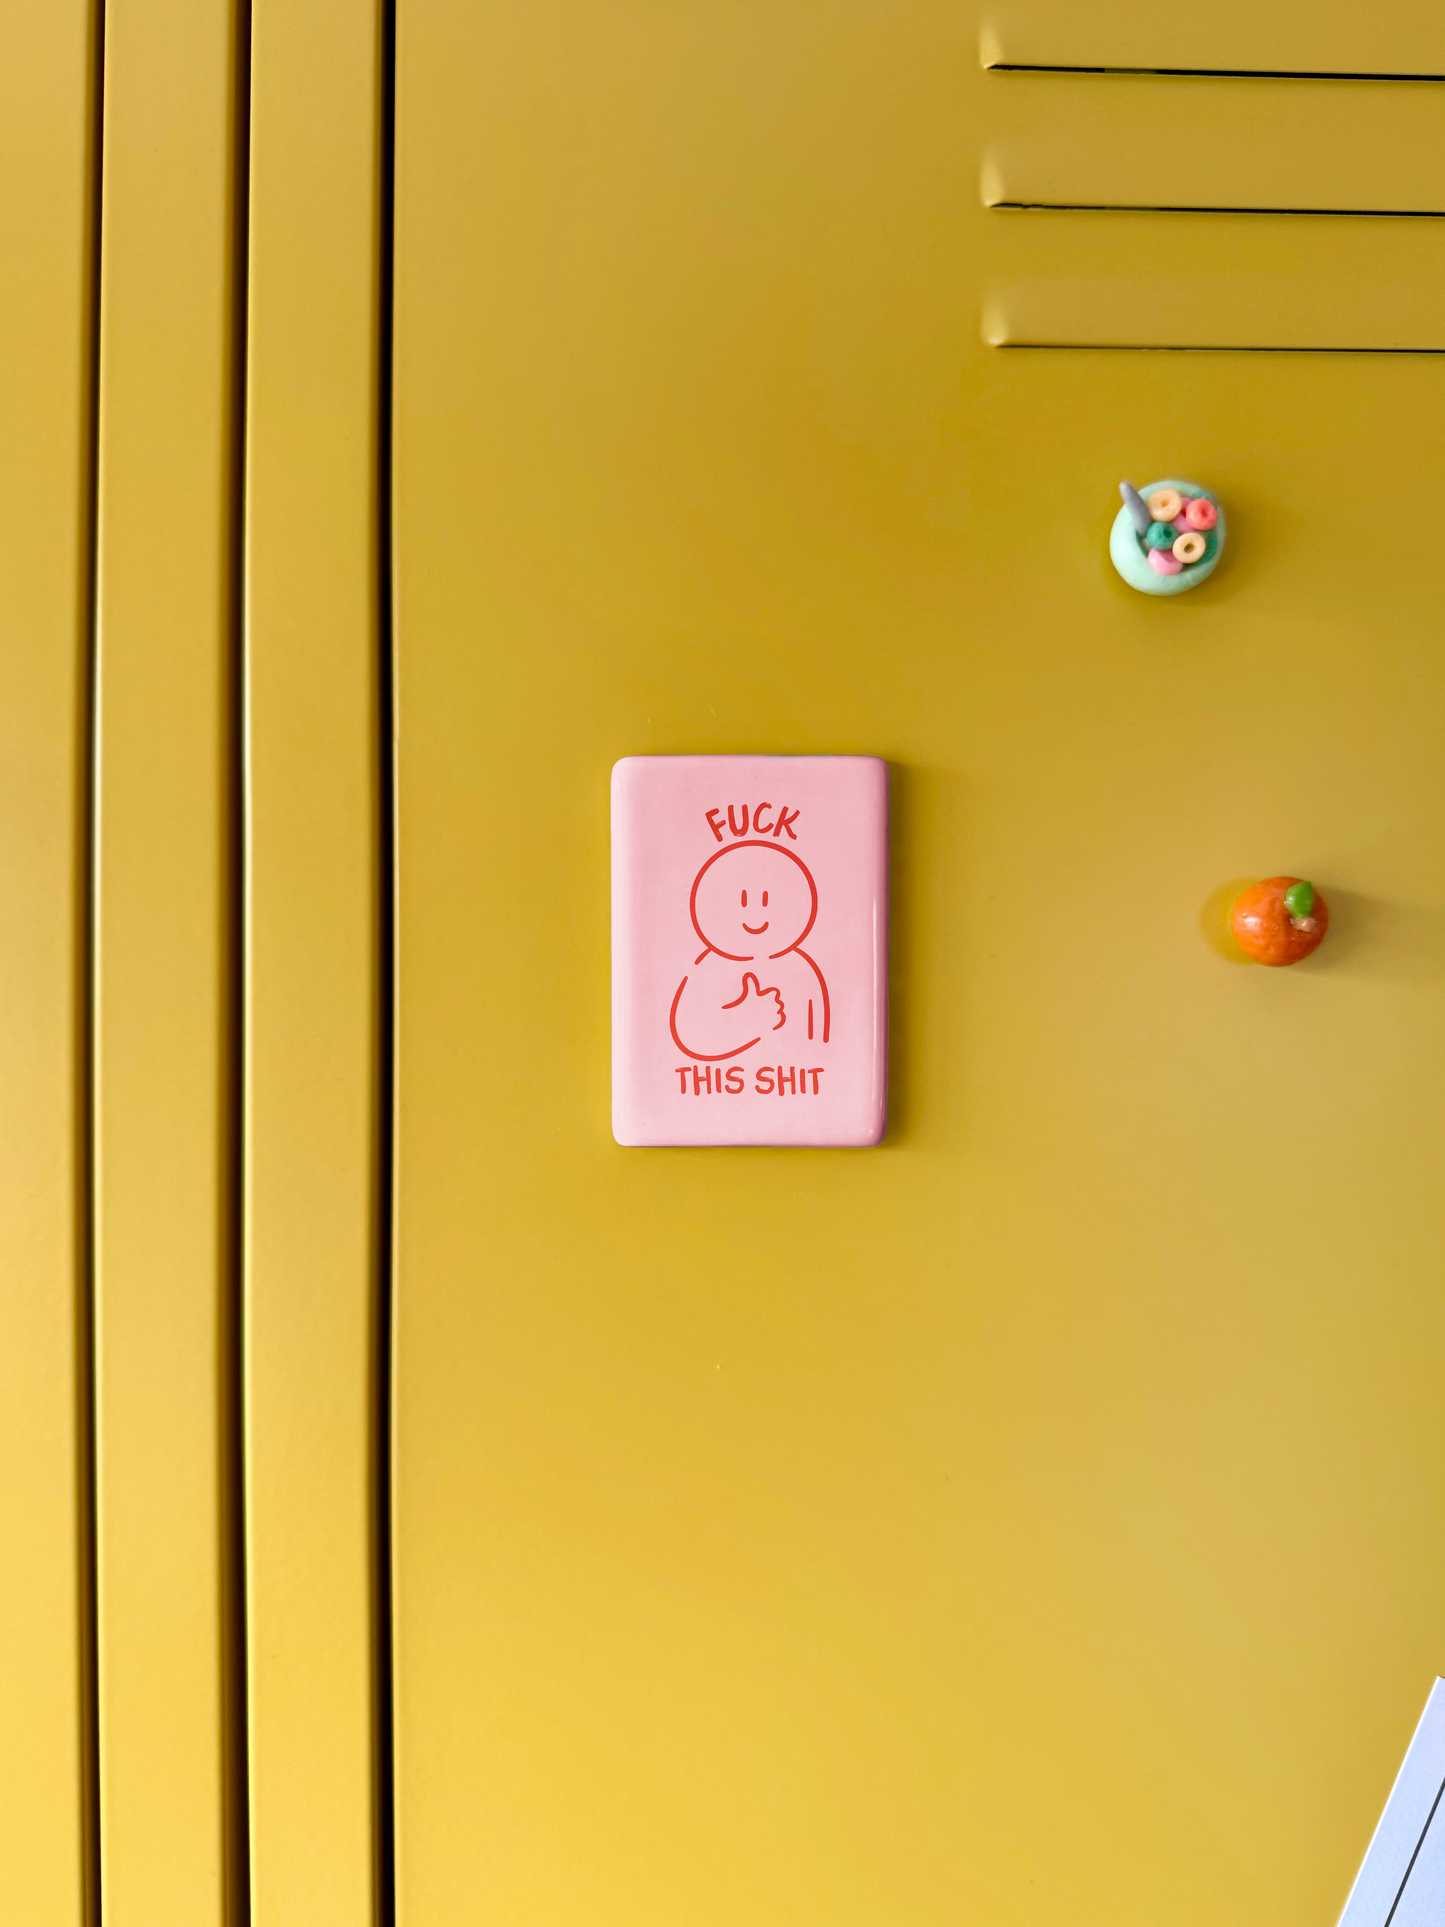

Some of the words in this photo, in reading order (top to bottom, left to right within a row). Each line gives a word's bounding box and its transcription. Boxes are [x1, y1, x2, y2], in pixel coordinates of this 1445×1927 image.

[705, 802, 800, 842] FUCK
[675, 1065, 745, 1096] THIS
[755, 1066, 825, 1096] SHIT
